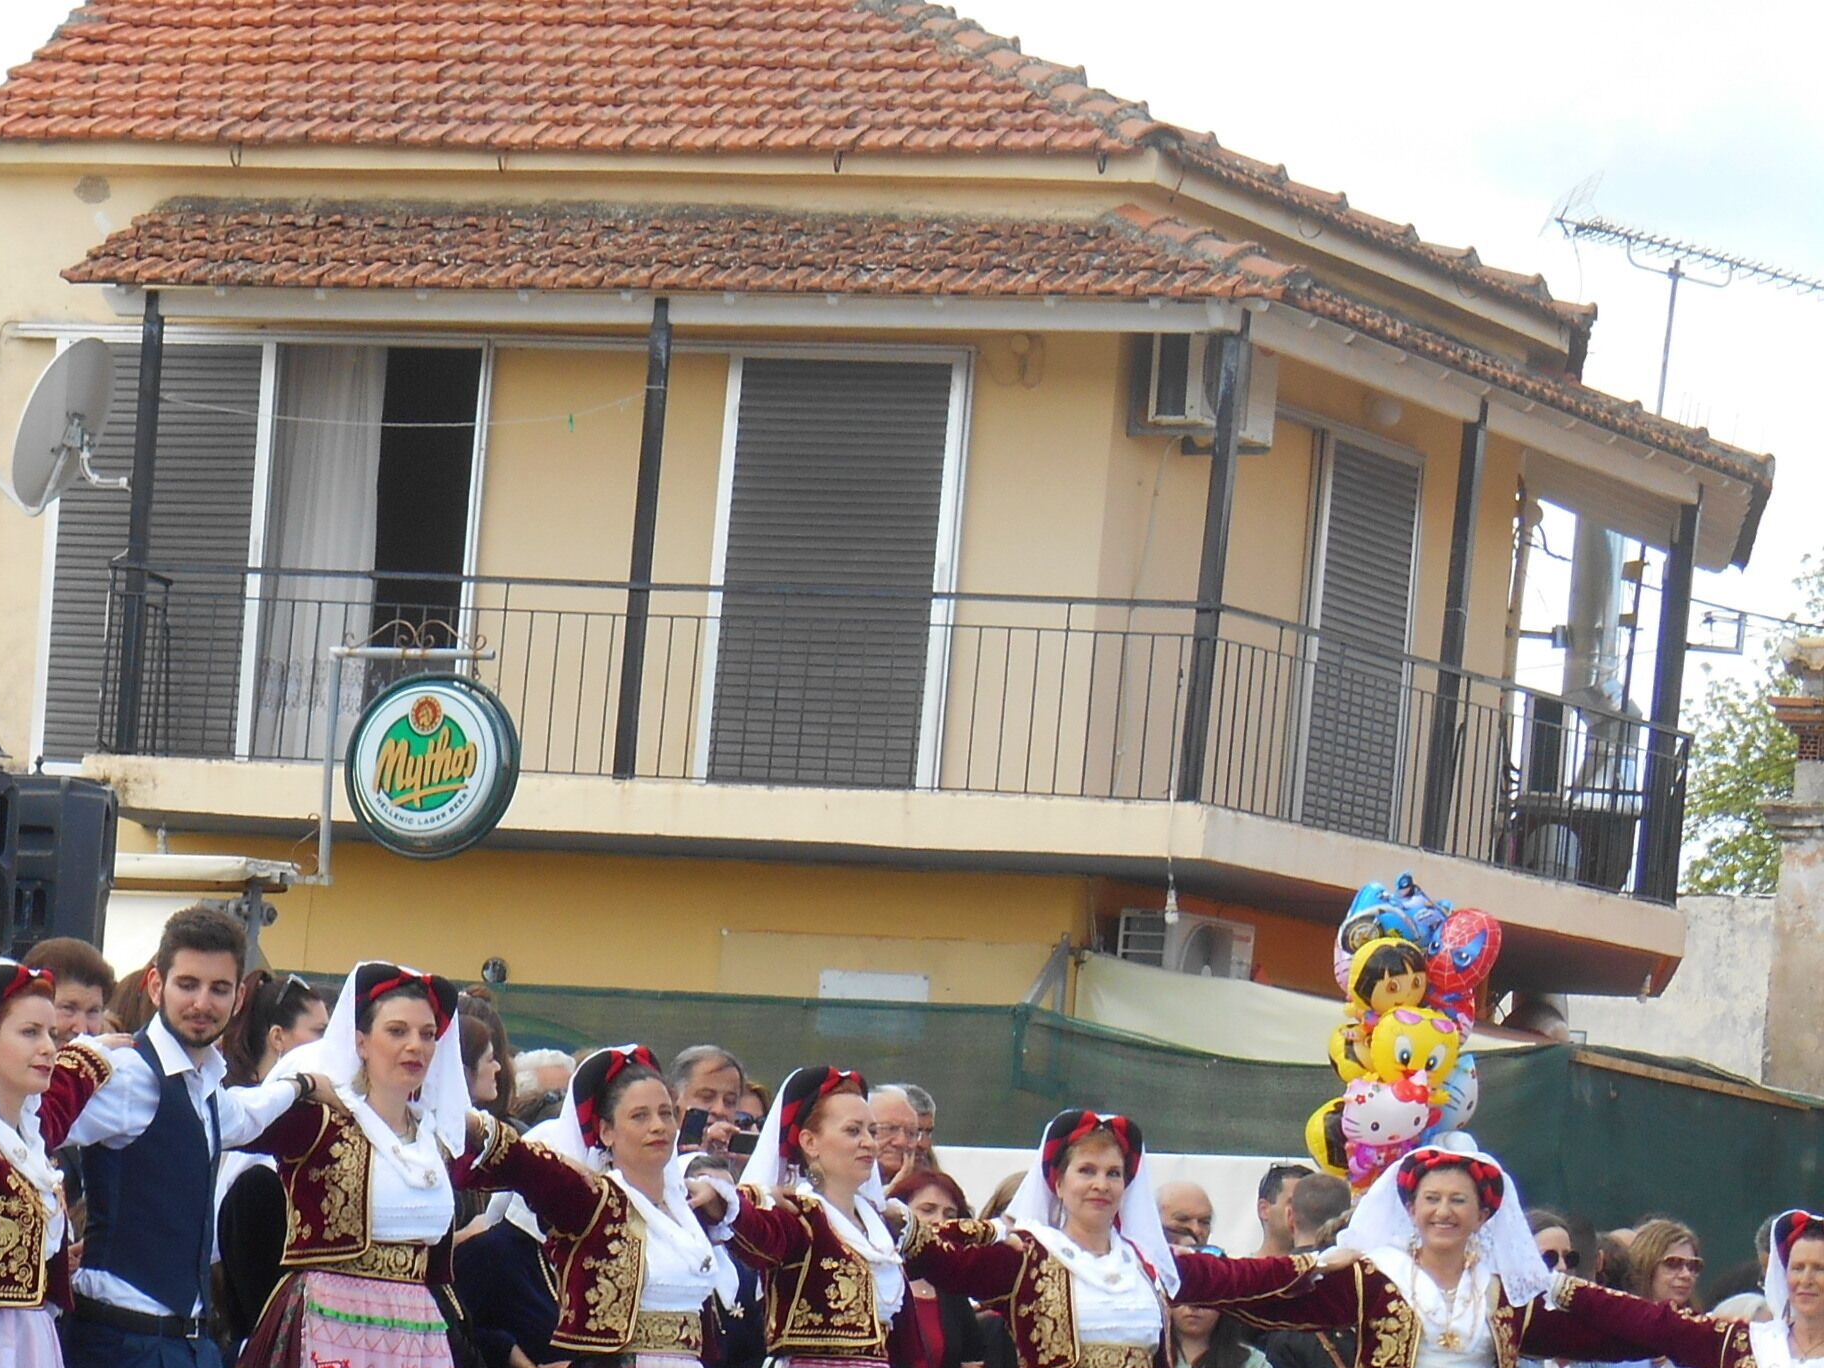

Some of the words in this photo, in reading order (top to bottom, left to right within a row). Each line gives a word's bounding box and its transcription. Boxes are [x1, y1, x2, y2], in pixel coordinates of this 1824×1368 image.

[373, 726, 477, 808] Mythos
[376, 796, 414, 825] HELLENIC
[417, 812, 446, 825] LAGER
[449, 793, 467, 814] BEER
